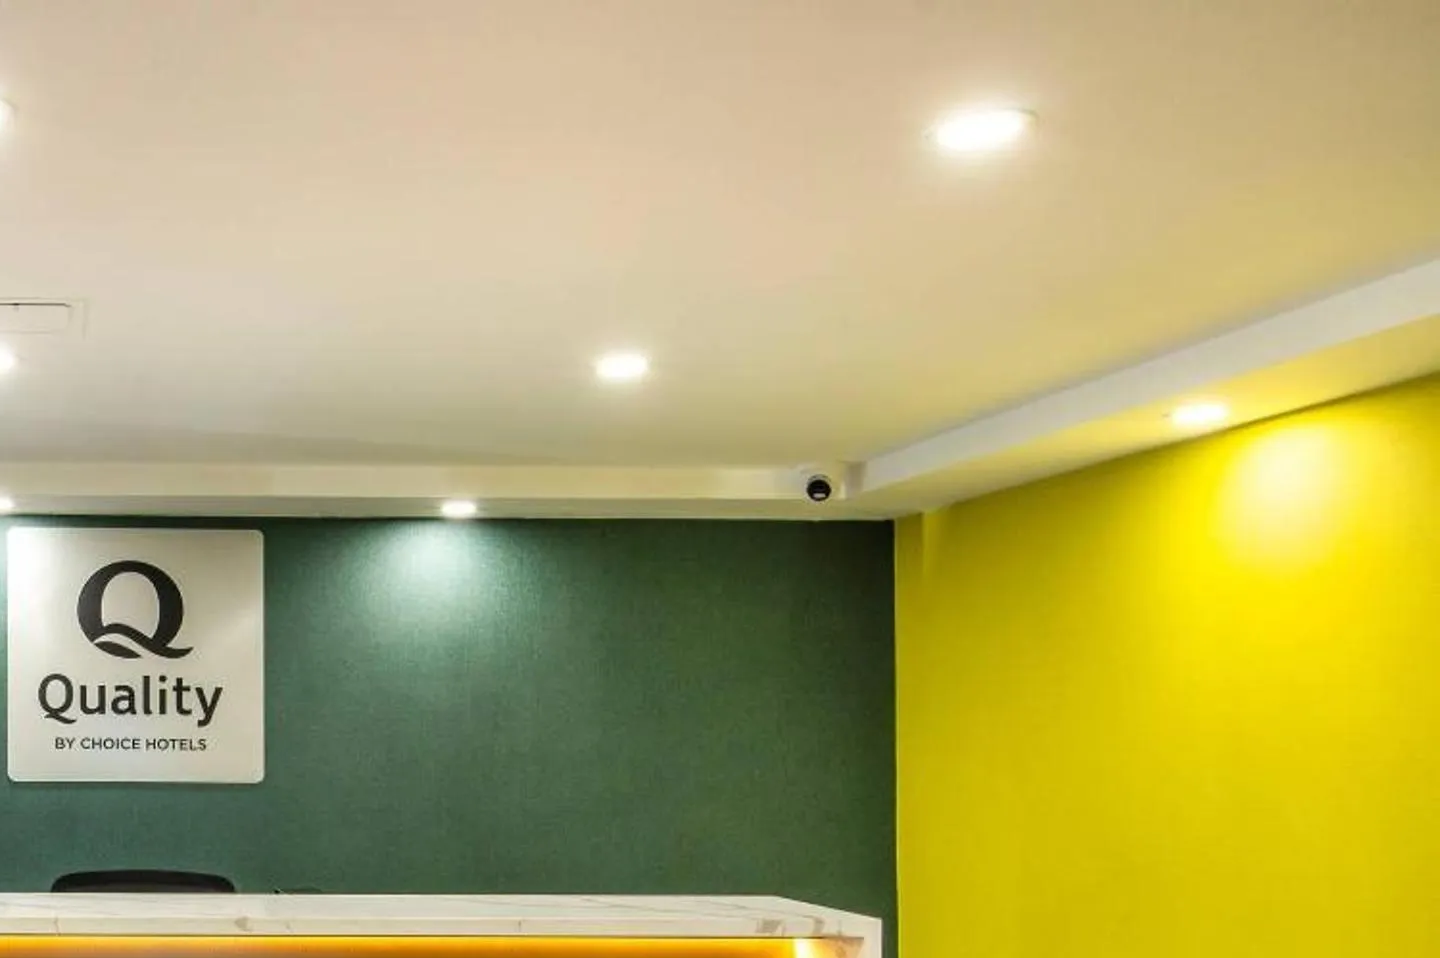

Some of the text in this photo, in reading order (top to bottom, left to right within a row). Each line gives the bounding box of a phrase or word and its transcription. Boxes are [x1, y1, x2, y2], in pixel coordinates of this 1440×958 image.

[76, 559, 194, 660] Q
[37, 672, 224, 728] Quality
[54, 736, 207, 751] BY CHOICE HOTELS
